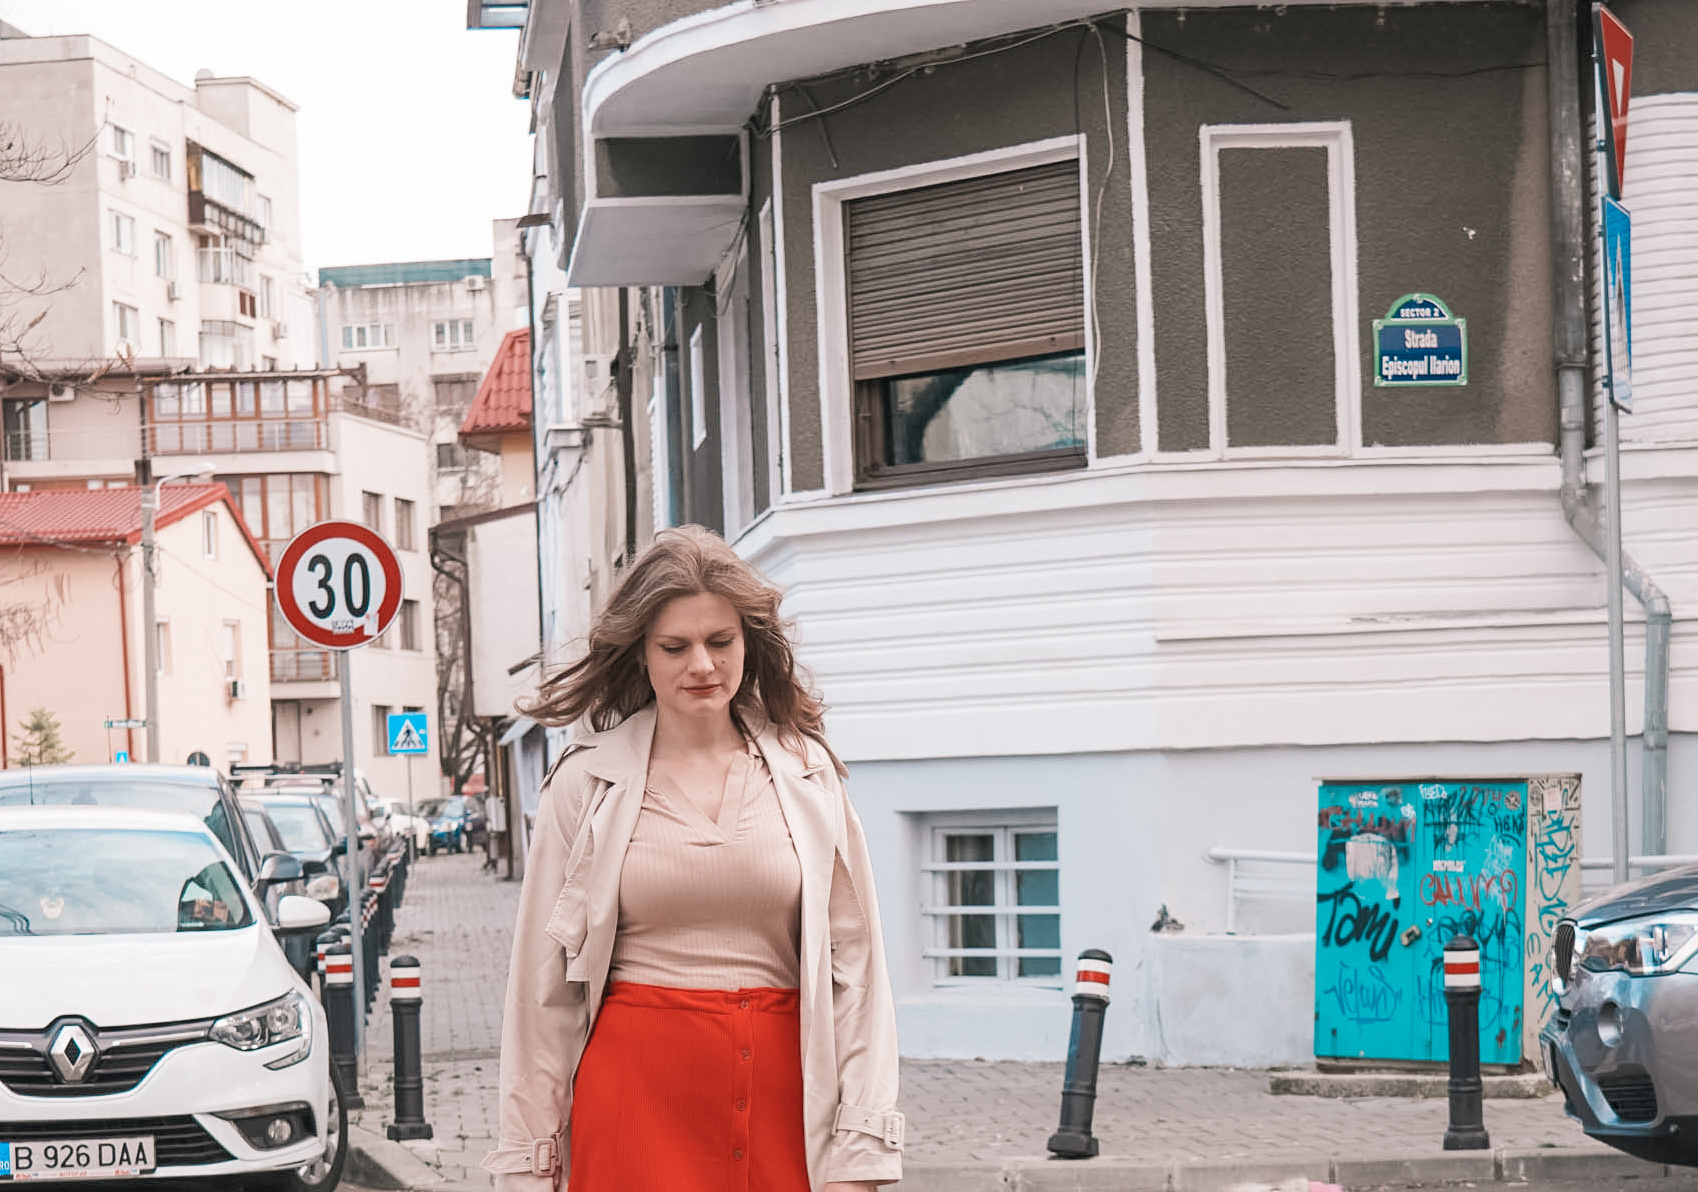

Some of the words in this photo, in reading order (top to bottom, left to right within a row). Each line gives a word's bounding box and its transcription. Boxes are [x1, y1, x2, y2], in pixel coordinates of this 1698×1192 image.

[1400, 308, 1431, 318] SECTOR
[1433, 308, 1440, 318] 2
[1404, 329, 1438, 349] Strada
[1381, 355, 1428, 380] Episcopul
[1430, 355, 1461, 375] Ilarion
[308, 553, 371, 619] 30
[15, 1146, 33, 1170] B
[44, 1144, 91, 1169] 926
[98, 1141, 148, 1167] DAA
